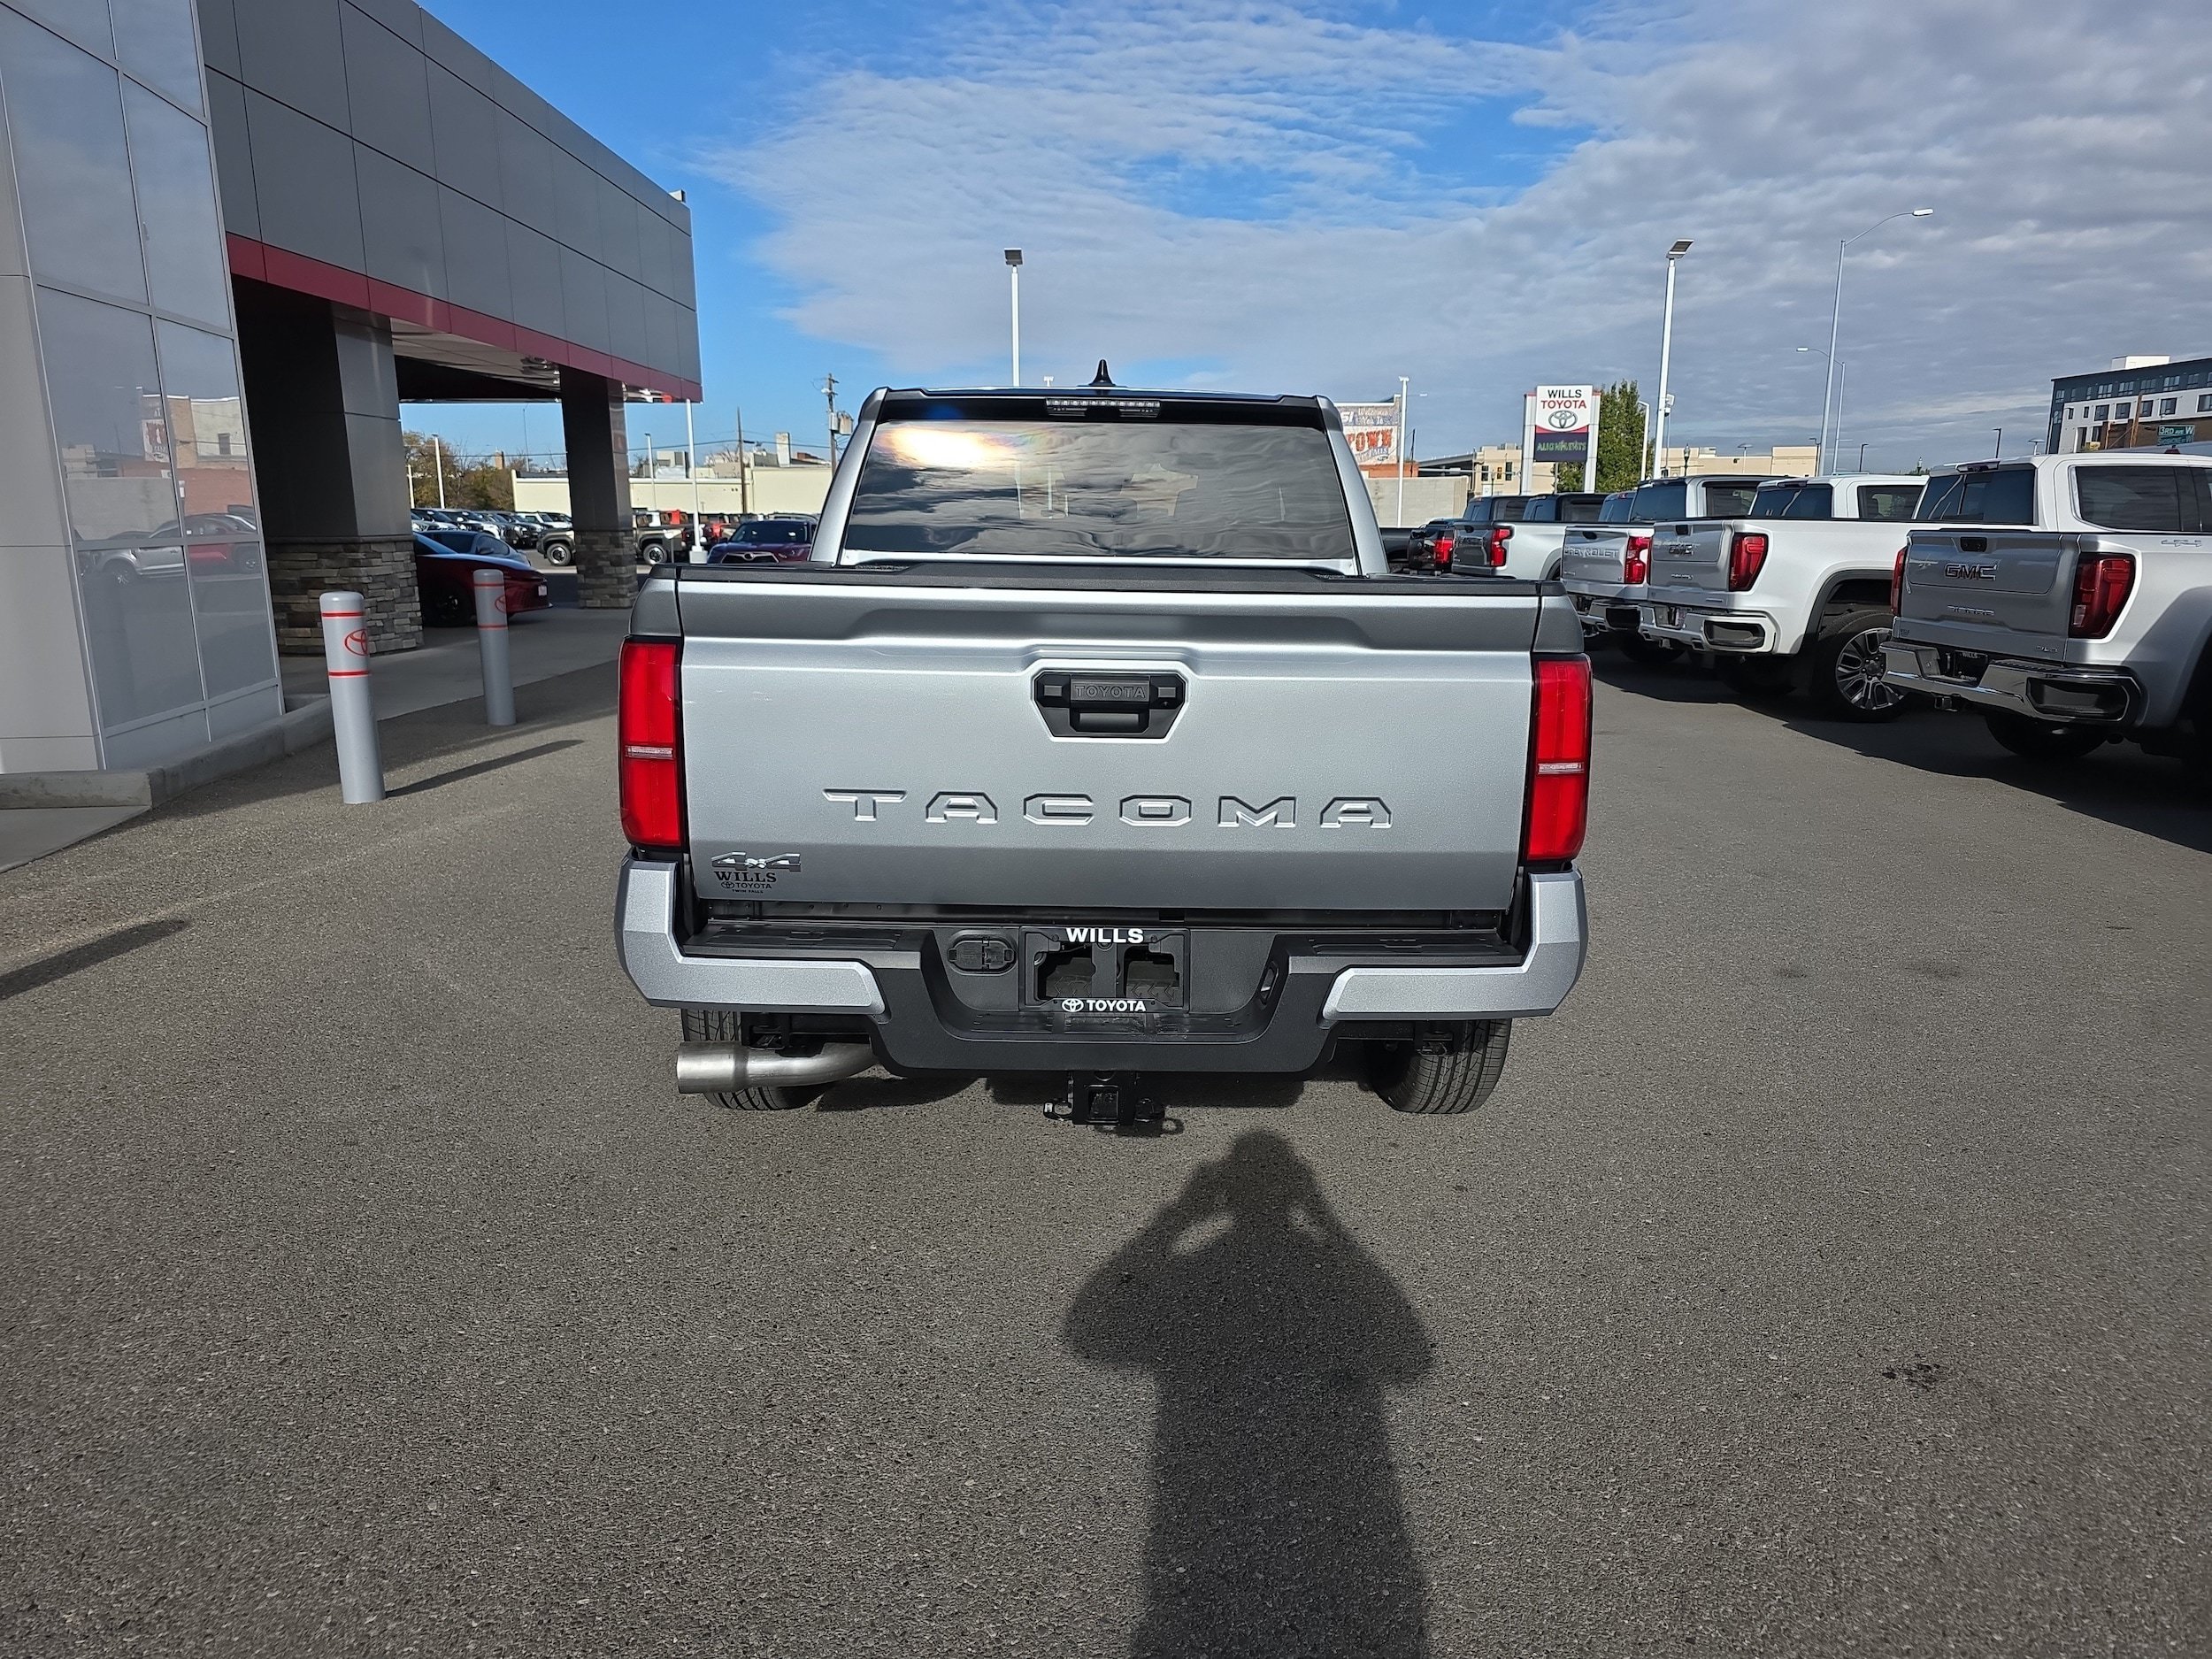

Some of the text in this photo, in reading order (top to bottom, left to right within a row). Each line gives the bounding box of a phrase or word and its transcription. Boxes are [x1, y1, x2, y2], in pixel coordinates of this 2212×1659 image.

[1548, 389, 1582, 398] WILLS
[1540, 400, 1586, 409] TOYOTA
[1946, 563, 1998, 580] GMC
[1074, 685, 1146, 699] TOYOTA
[822, 788, 1394, 829] TACOMA
[714, 871, 777, 883] WILLS
[1065, 927, 1144, 943] WILLS
[1087, 1000, 1147, 1012] TOYOTA
